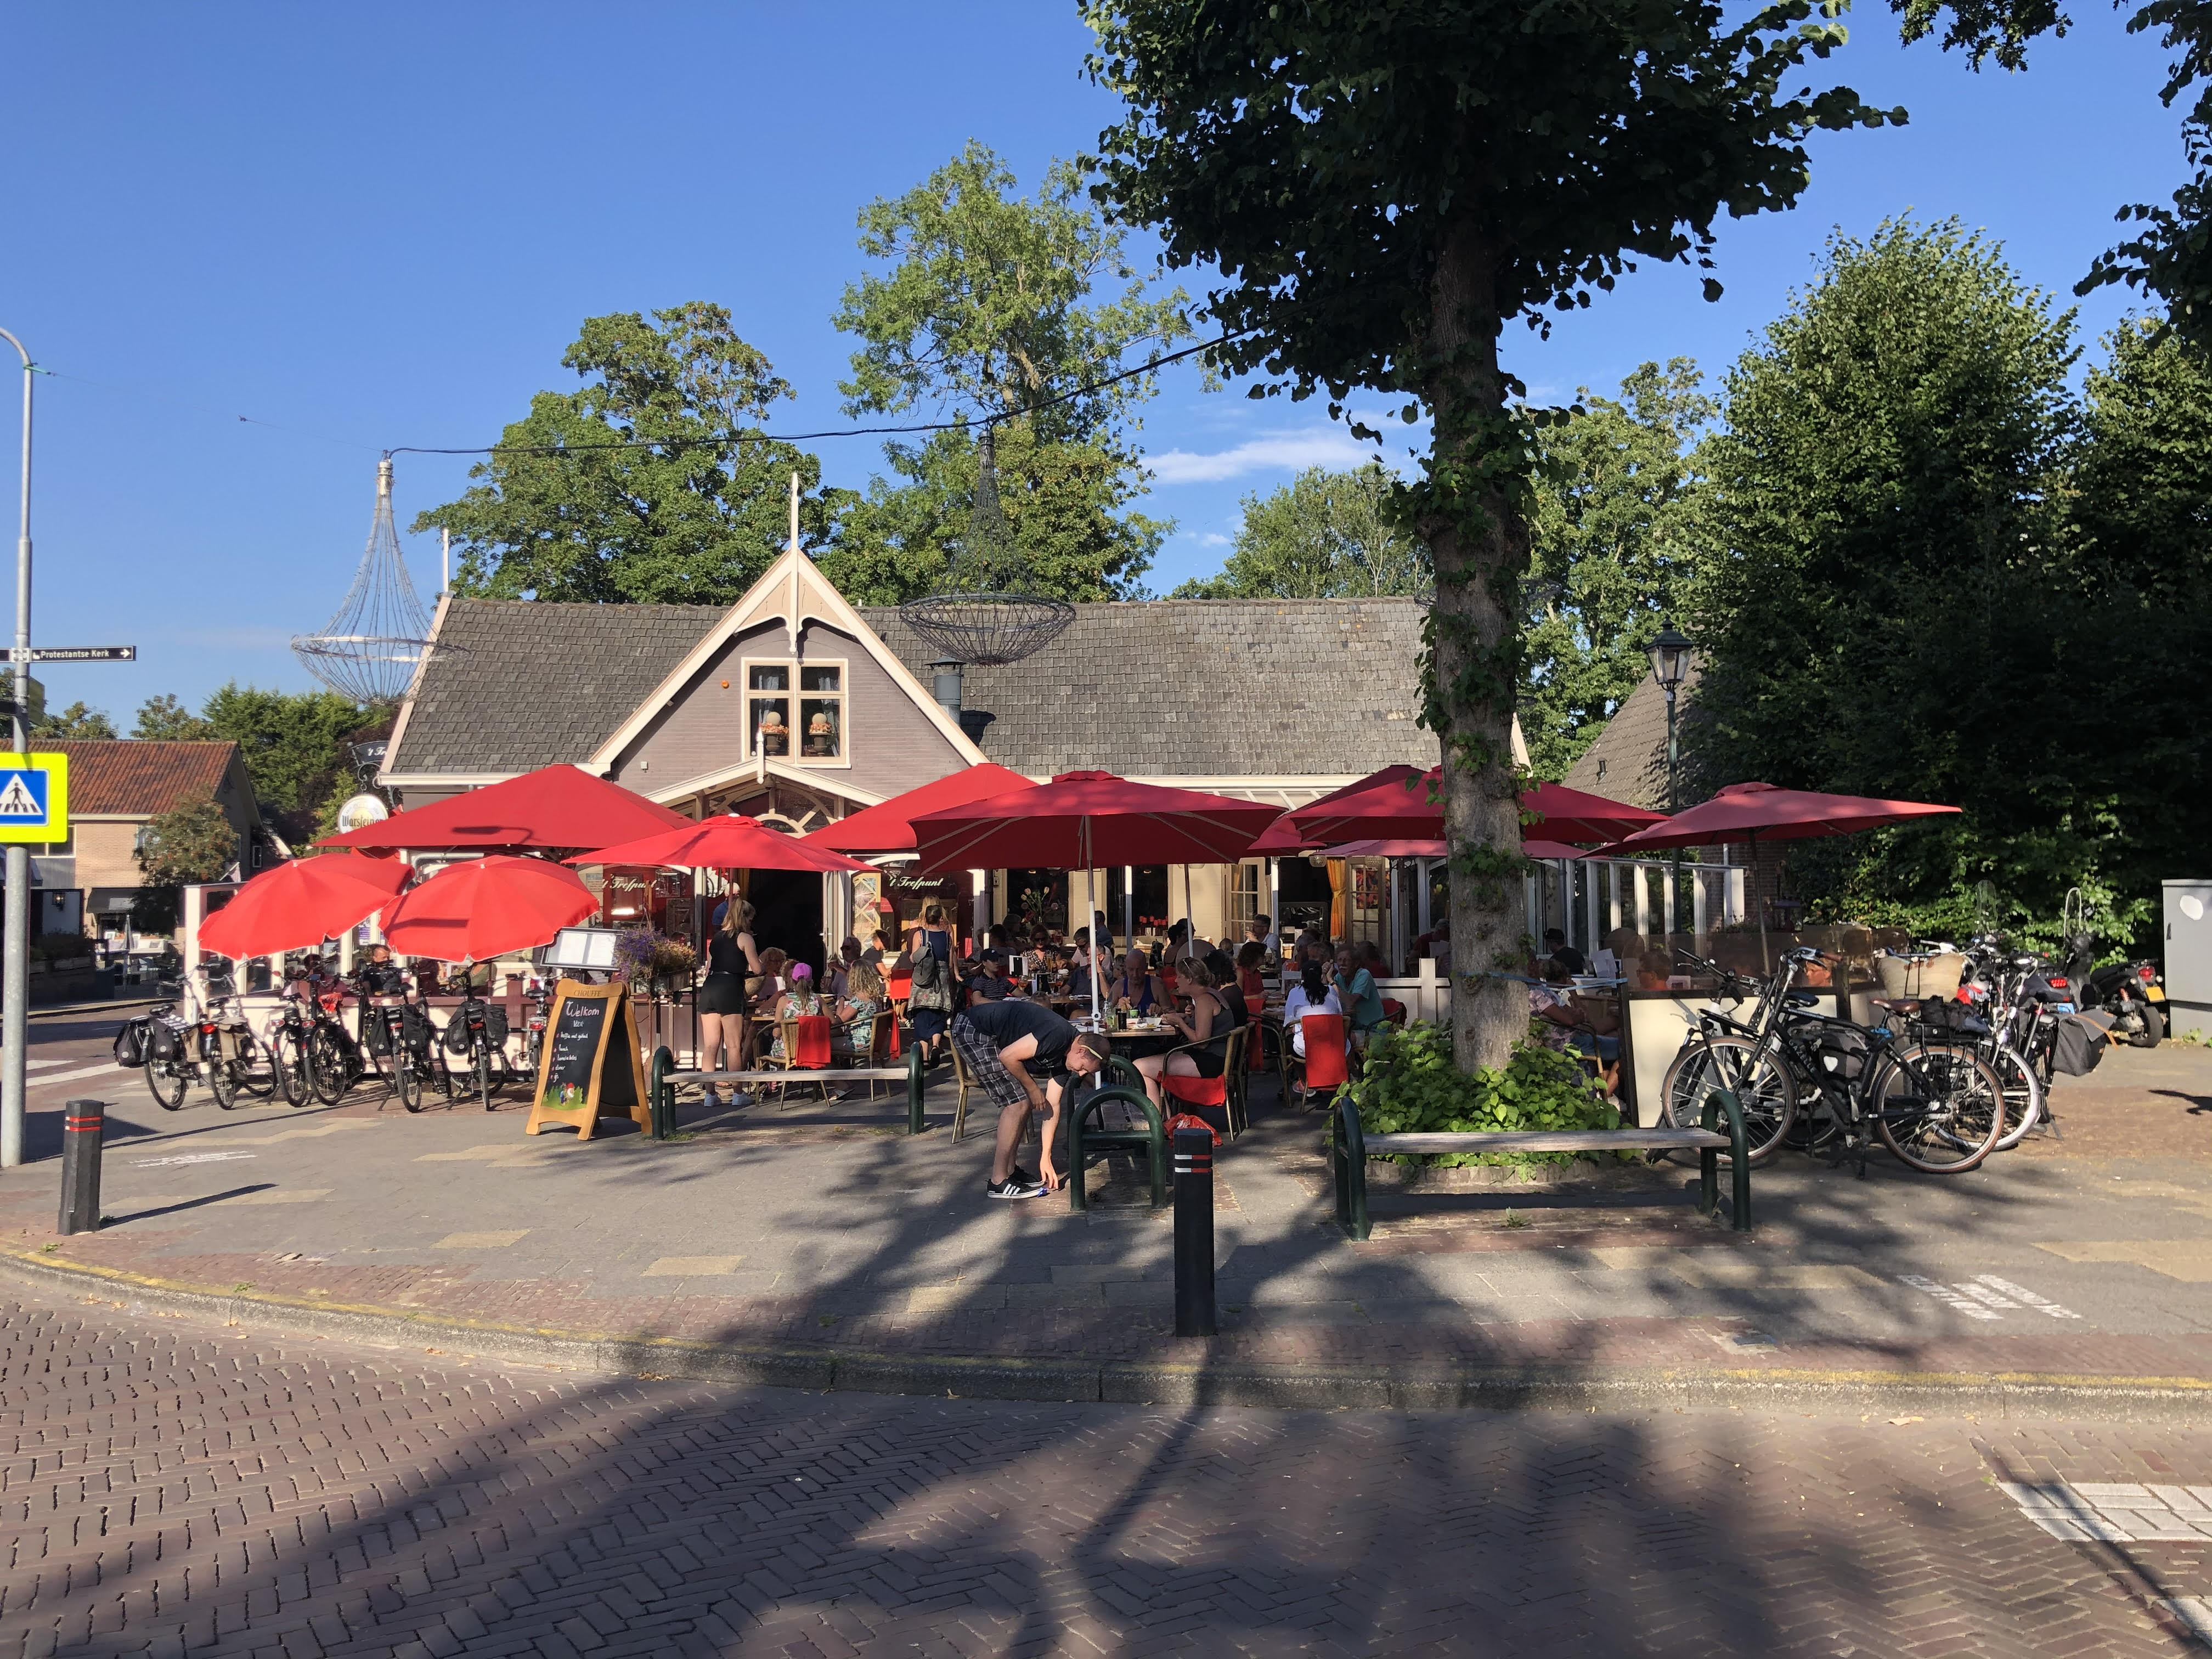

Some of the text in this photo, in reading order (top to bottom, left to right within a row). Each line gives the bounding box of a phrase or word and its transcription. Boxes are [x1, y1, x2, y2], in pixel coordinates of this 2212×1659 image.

[41, 650, 89, 658] Protestantse
[610, 878, 657, 892] Trefput
[897, 876, 944, 890] Trefpunt
[566, 1000, 600, 1017] Welkom
